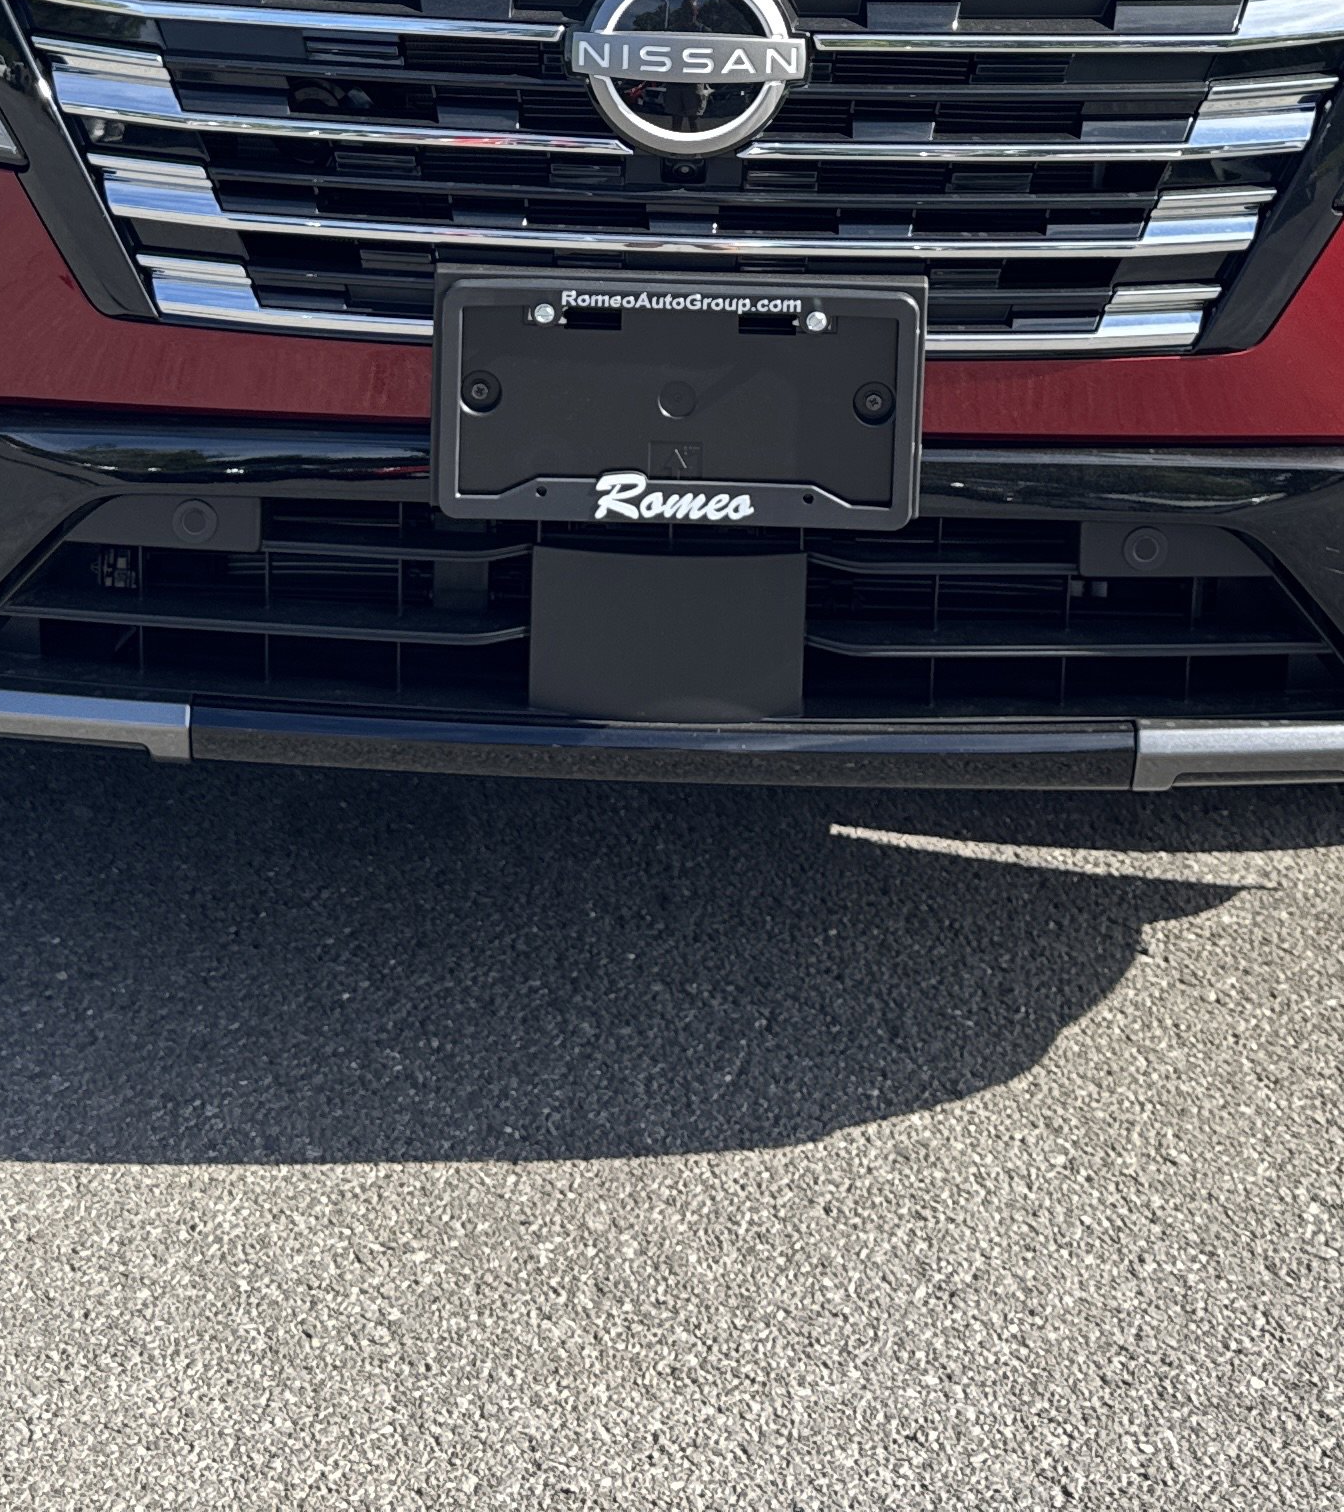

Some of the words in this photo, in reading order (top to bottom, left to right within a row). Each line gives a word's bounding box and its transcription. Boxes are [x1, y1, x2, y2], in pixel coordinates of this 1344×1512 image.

[578, 40, 797, 74] NISSAN
[561, 290, 802, 314] RomeoAutoGroup.com
[594, 473, 755, 521] Romeo
